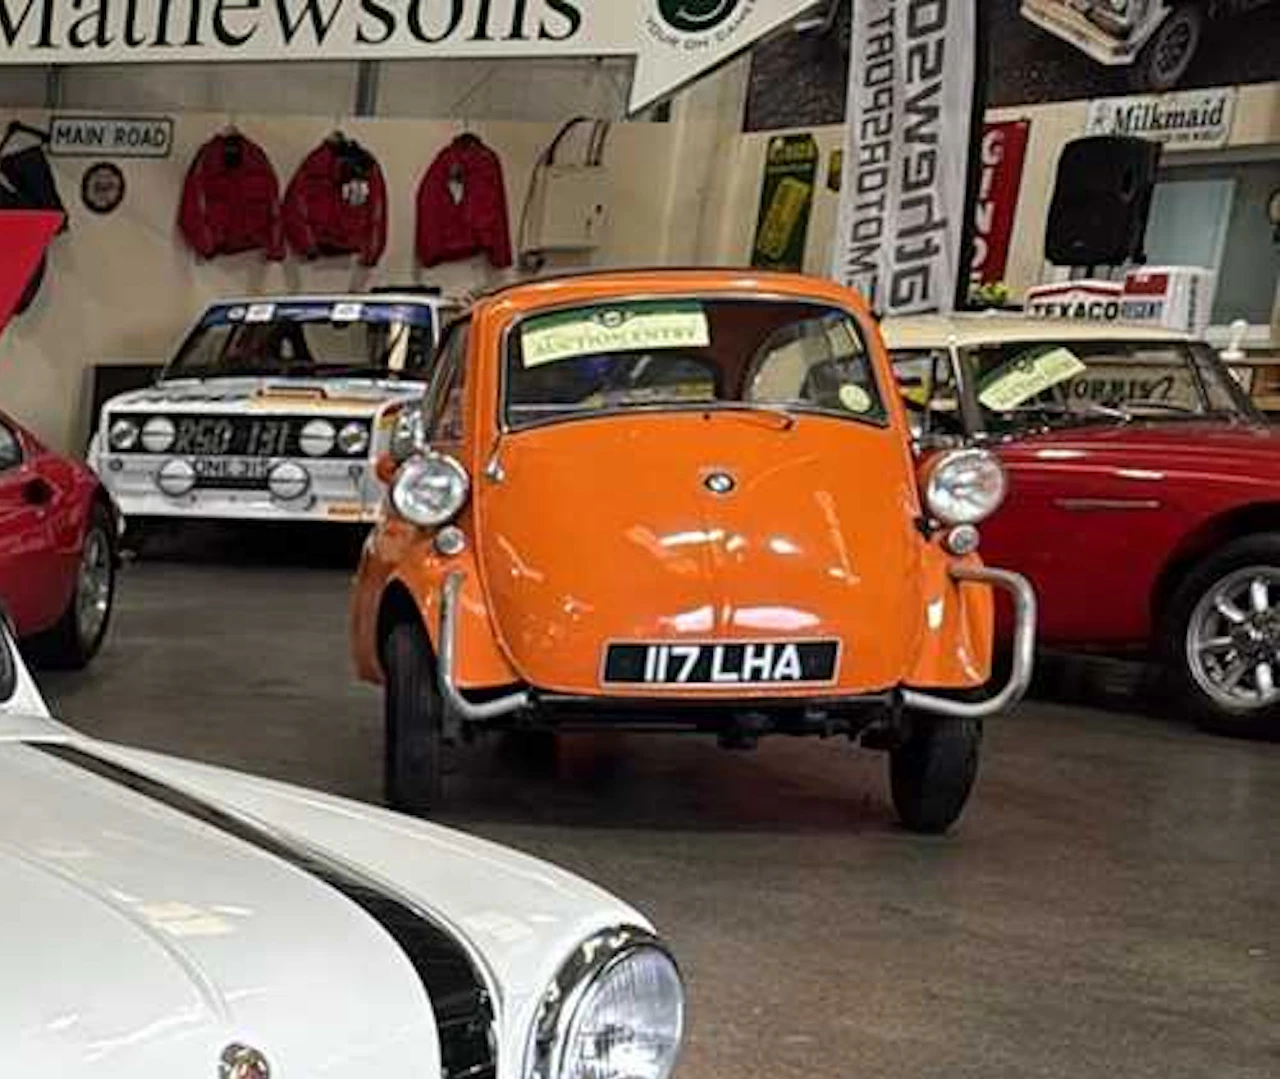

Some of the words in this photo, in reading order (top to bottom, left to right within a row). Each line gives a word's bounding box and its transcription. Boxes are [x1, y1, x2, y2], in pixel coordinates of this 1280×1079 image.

[1112, 98, 1227, 134] Milkmaid
[56, 125, 105, 145] MAIN
[114, 125, 166, 147] ROAD
[1031, 301, 1120, 321] TEXACO
[644, 645, 701, 682] 117
[711, 644, 802, 681] LHA
